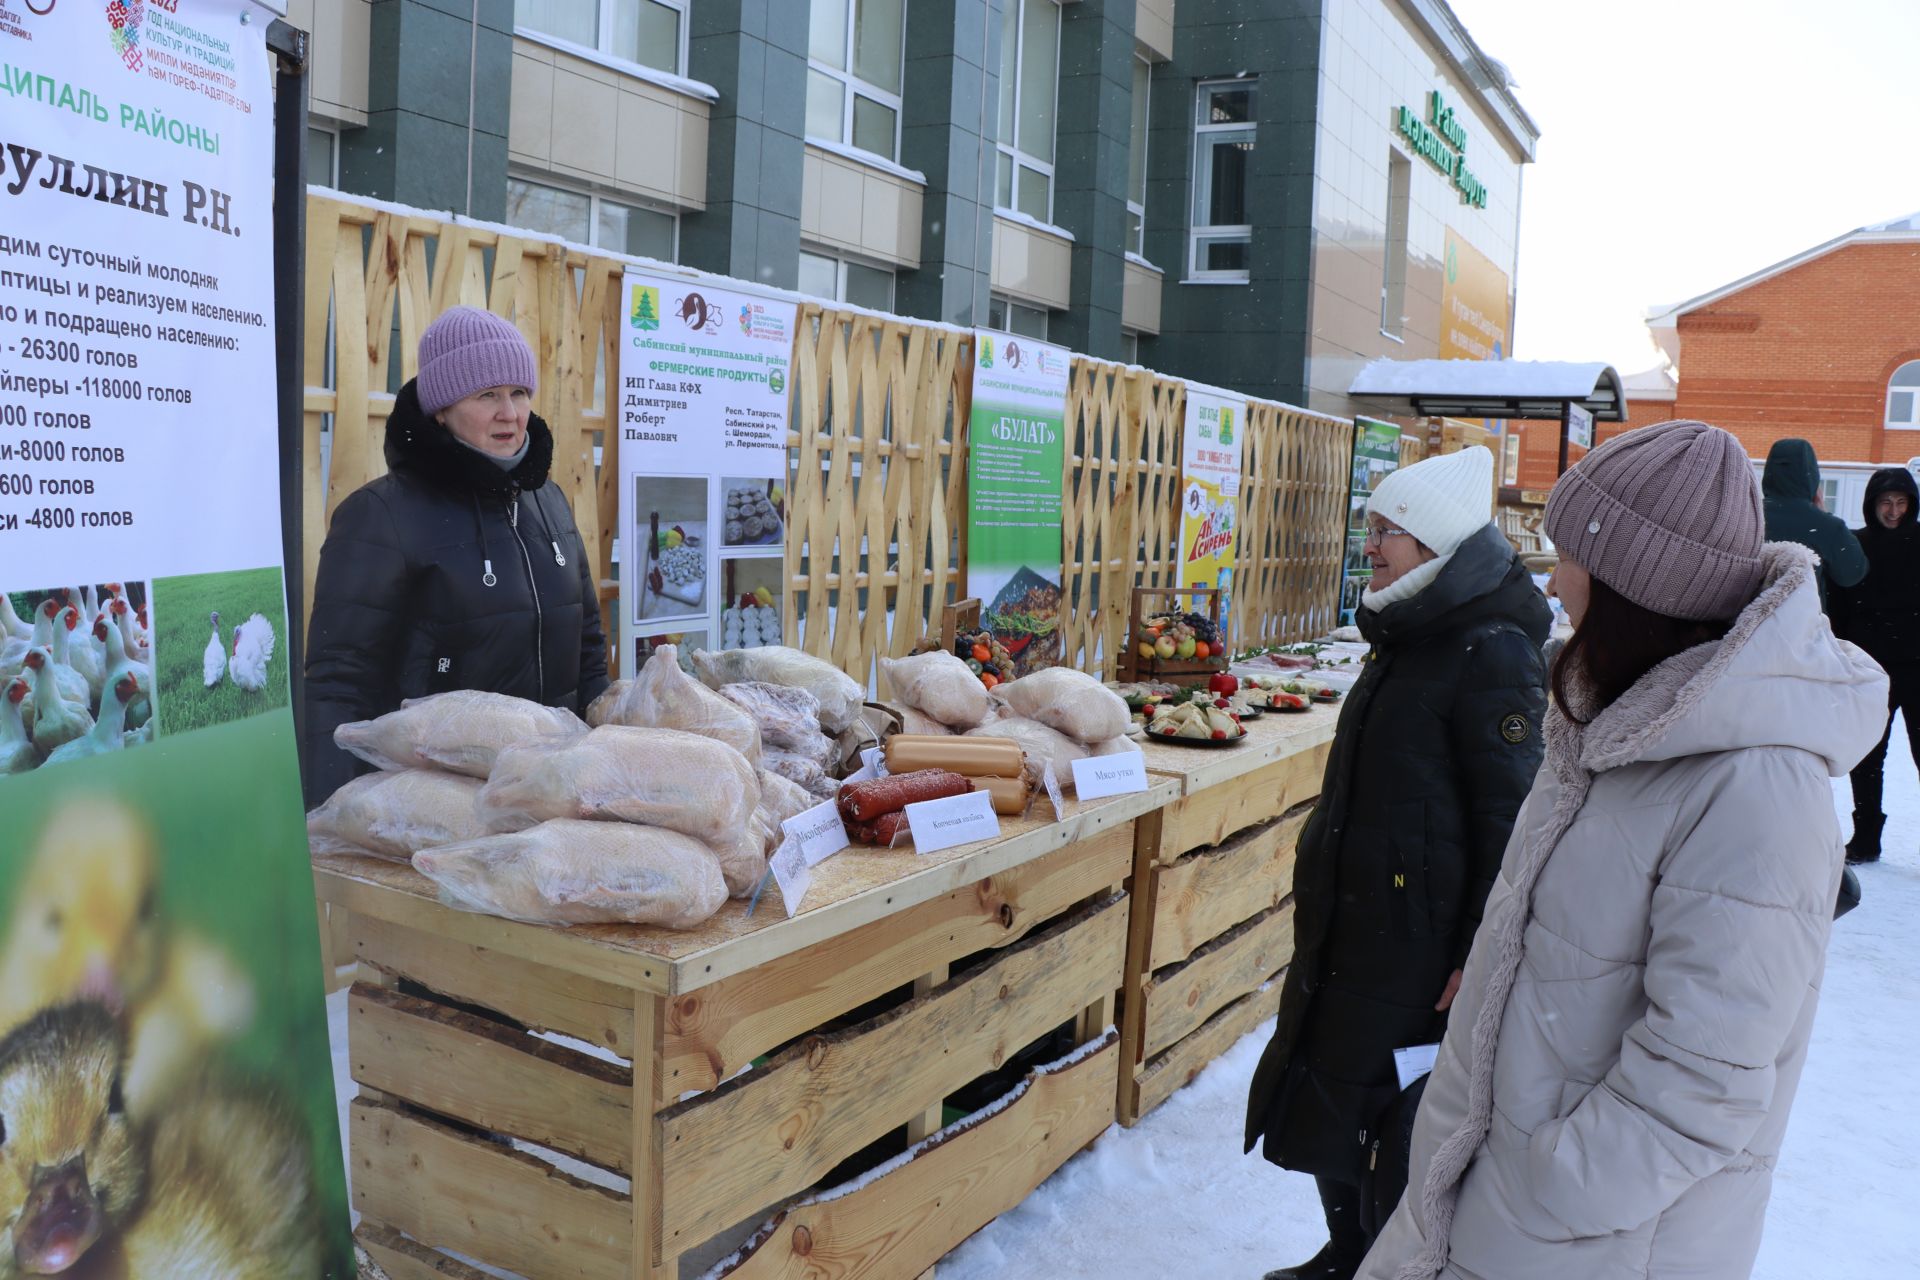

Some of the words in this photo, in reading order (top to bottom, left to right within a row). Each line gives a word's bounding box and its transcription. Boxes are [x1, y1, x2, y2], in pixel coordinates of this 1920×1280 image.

[147, 10, 162, 29] ГОД
[164, 18, 230, 54] НАЦИОНАЛЬНЫХ
[146, 27, 182, 52] КУЛЬТУР
[184, 43, 191, 56] И
[193, 46, 235, 72] ТРАДИЦИЙ
[146, 48, 178, 68] МИЛЛИ
[120, 103, 219, 155] РАЙОНЫ
[0, 142, 169, 217] уллин
[183, 180, 241, 237] Р.Н.
[48, 244, 142, 277] суточный
[147, 262, 219, 291] молодняк
[1, 270, 71, 297] птицы
[78, 281, 89, 298] и
[95, 284, 187, 315] реализуем
[192, 301, 267, 328] населению.
[25, 308, 37, 325] и
[45, 310, 152, 340] подращено
[157, 324, 239, 351] населению:
[21, 337, 80, 364] 26300
[86, 348, 138, 368] голов
[632, 336, 686, 354] Сабинский
[689, 346, 763, 363] муниципальный
[649, 360, 714, 378] ФЕРМЕРСКИЕ
[717, 367, 768, 384] ПРОДУКТЫ
[75, 377, 142, 401] -118000
[147, 385, 192, 404] голов
[625, 377, 645, 389] ИП
[649, 378, 676, 392] Глава
[680, 382, 702, 394] КФХ
[0, 404, 27, 427] 00
[33, 410, 91, 429] голов
[625, 412, 666, 427] Роберт
[725, 406, 744, 416] Респ.
[746, 408, 782, 419] Татарстан,
[725, 419, 764, 429] Сабинский
[625, 429, 678, 442] Павлович
[991, 416, 1055, 444] «БУЛАТ»
[71, 446, 124, 463] голов
[39, 478, 95, 495] голов
[25, 507, 75, 529] -4800
[81, 510, 133, 527] голов
[1094, 770, 1115, 781] Мясо
[1117, 769, 1134, 780] утки
